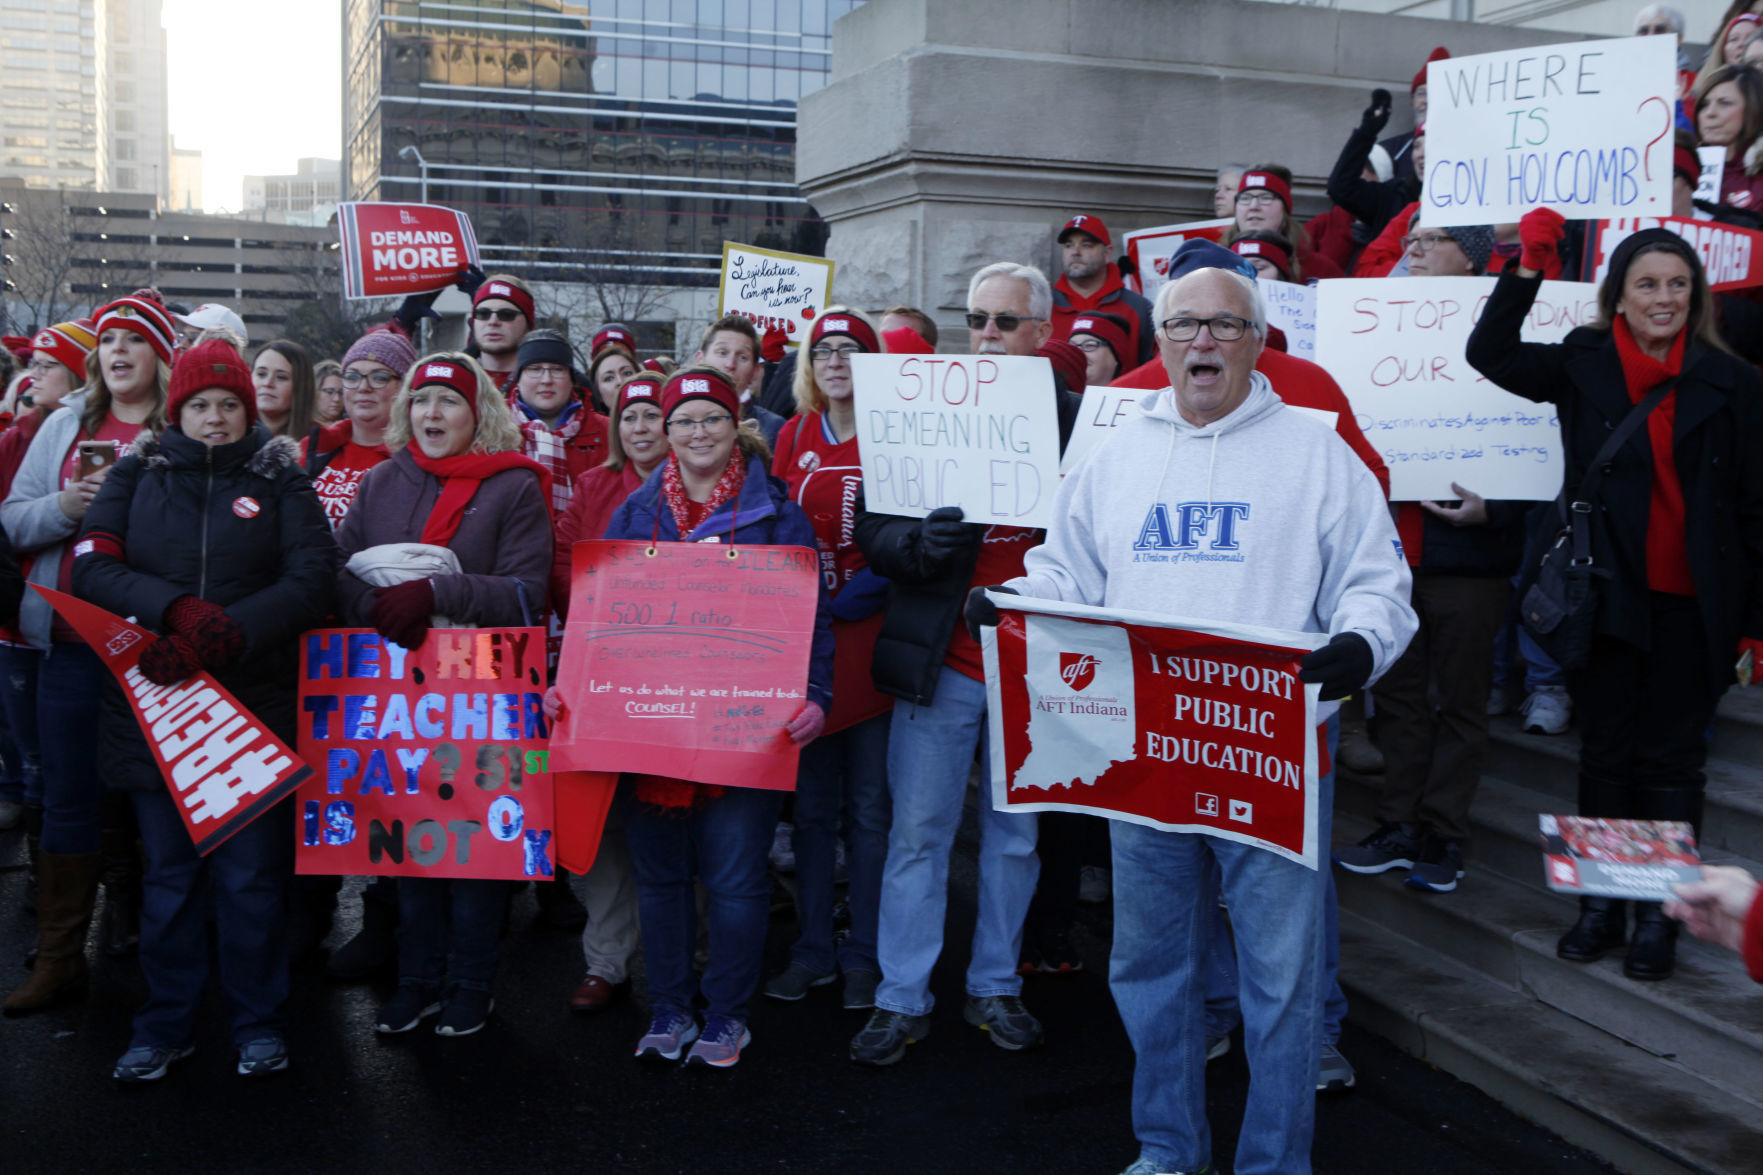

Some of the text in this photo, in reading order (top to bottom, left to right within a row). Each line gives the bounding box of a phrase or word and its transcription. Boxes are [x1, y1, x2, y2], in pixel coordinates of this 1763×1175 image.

[1444, 52, 1604, 108] WHERE
[1505, 107, 1550, 150] IS
[1429, 157, 1491, 208] GOV.
[371, 231, 454, 246] DEMAND
[373, 246, 459, 271] MORE
[732, 256, 800, 288] Legislature,
[740, 278, 797, 300] Can you hear
[768, 299, 783, 308] us
[1268, 284, 1304, 303] Hello
[1352, 298, 1460, 333] STOP
[895, 358, 999, 406] STOP
[1371, 356, 1455, 387] OUR
[870, 410, 1030, 454] DEMEANING
[1384, 443, 1549, 464] Standardized Testing
[873, 453, 1042, 517] PUBLIC ED
[1133, 501, 1251, 551] AFT
[738, 551, 818, 573] ILEARN
[1142, 552, 1169, 562] Union
[1171, 552, 1182, 564] of
[1181, 552, 1245, 563] Professionals
[690, 607, 733, 626] ratio
[590, 680, 613, 693] Let
[619, 686, 634, 695] us
[637, 684, 652, 695] do
[655, 684, 684, 696] what
[689, 688, 706, 697] we
[710, 688, 728, 697] are
[733, 686, 773, 698] trained
[1150, 652, 1296, 701] I SUPPORT
[304, 692, 549, 740] TEACHER
[625, 701, 695, 715] COUNSEL!
[1036, 700, 1128, 716] AFT Indiana
[1175, 694, 1275, 738] PUBLIC
[1146, 731, 1301, 791] EDUCATION
[304, 795, 555, 876] IS NOT OK
